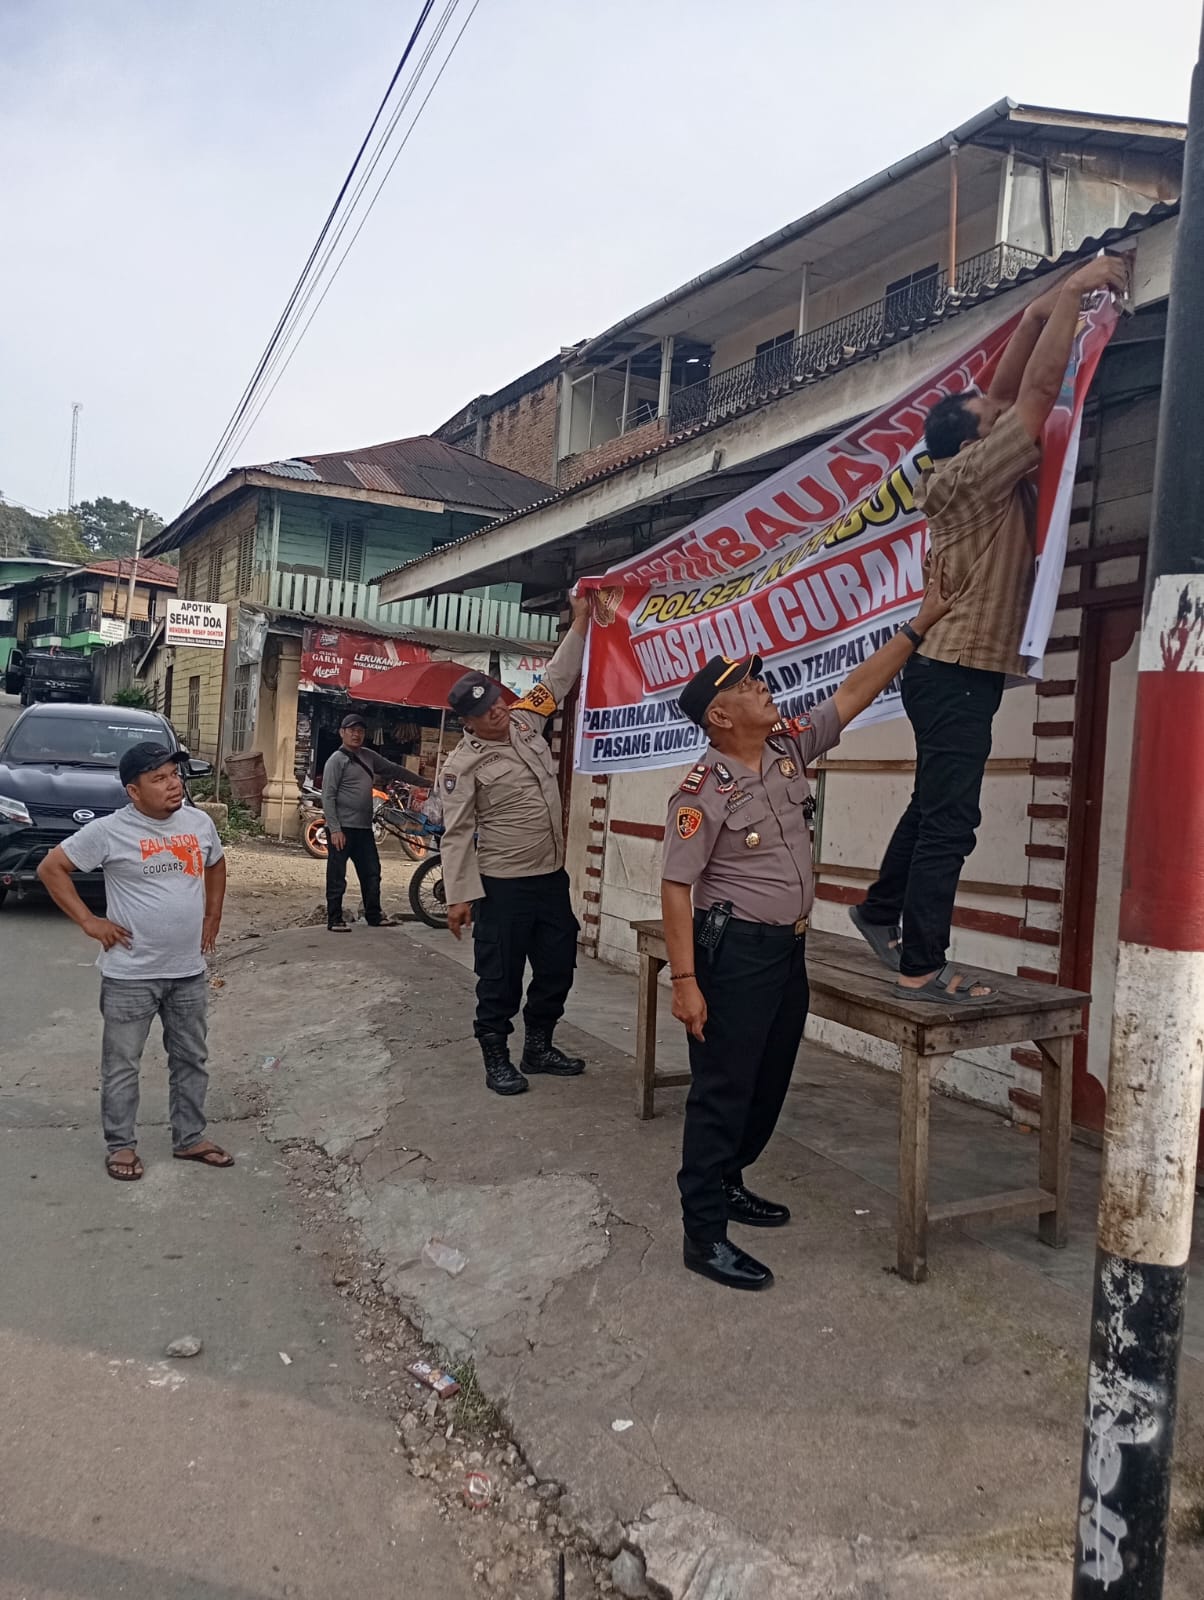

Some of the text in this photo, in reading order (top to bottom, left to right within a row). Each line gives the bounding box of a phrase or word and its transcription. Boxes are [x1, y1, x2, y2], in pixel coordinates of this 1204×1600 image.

[181, 602, 212, 613] APOTIK
[634, 527, 932, 688] WASPADA CURAN
[169, 612, 222, 628] SEHAT DOA
[312, 653, 344, 665] GARAM
[584, 700, 666, 731] PARKIRKAN
[778, 662, 802, 690] DI
[802, 633, 866, 682] TEMPAT
[592, 732, 652, 759] PASANG
[653, 725, 700, 752] KUNCI
[143, 861, 183, 875] COUGARS
